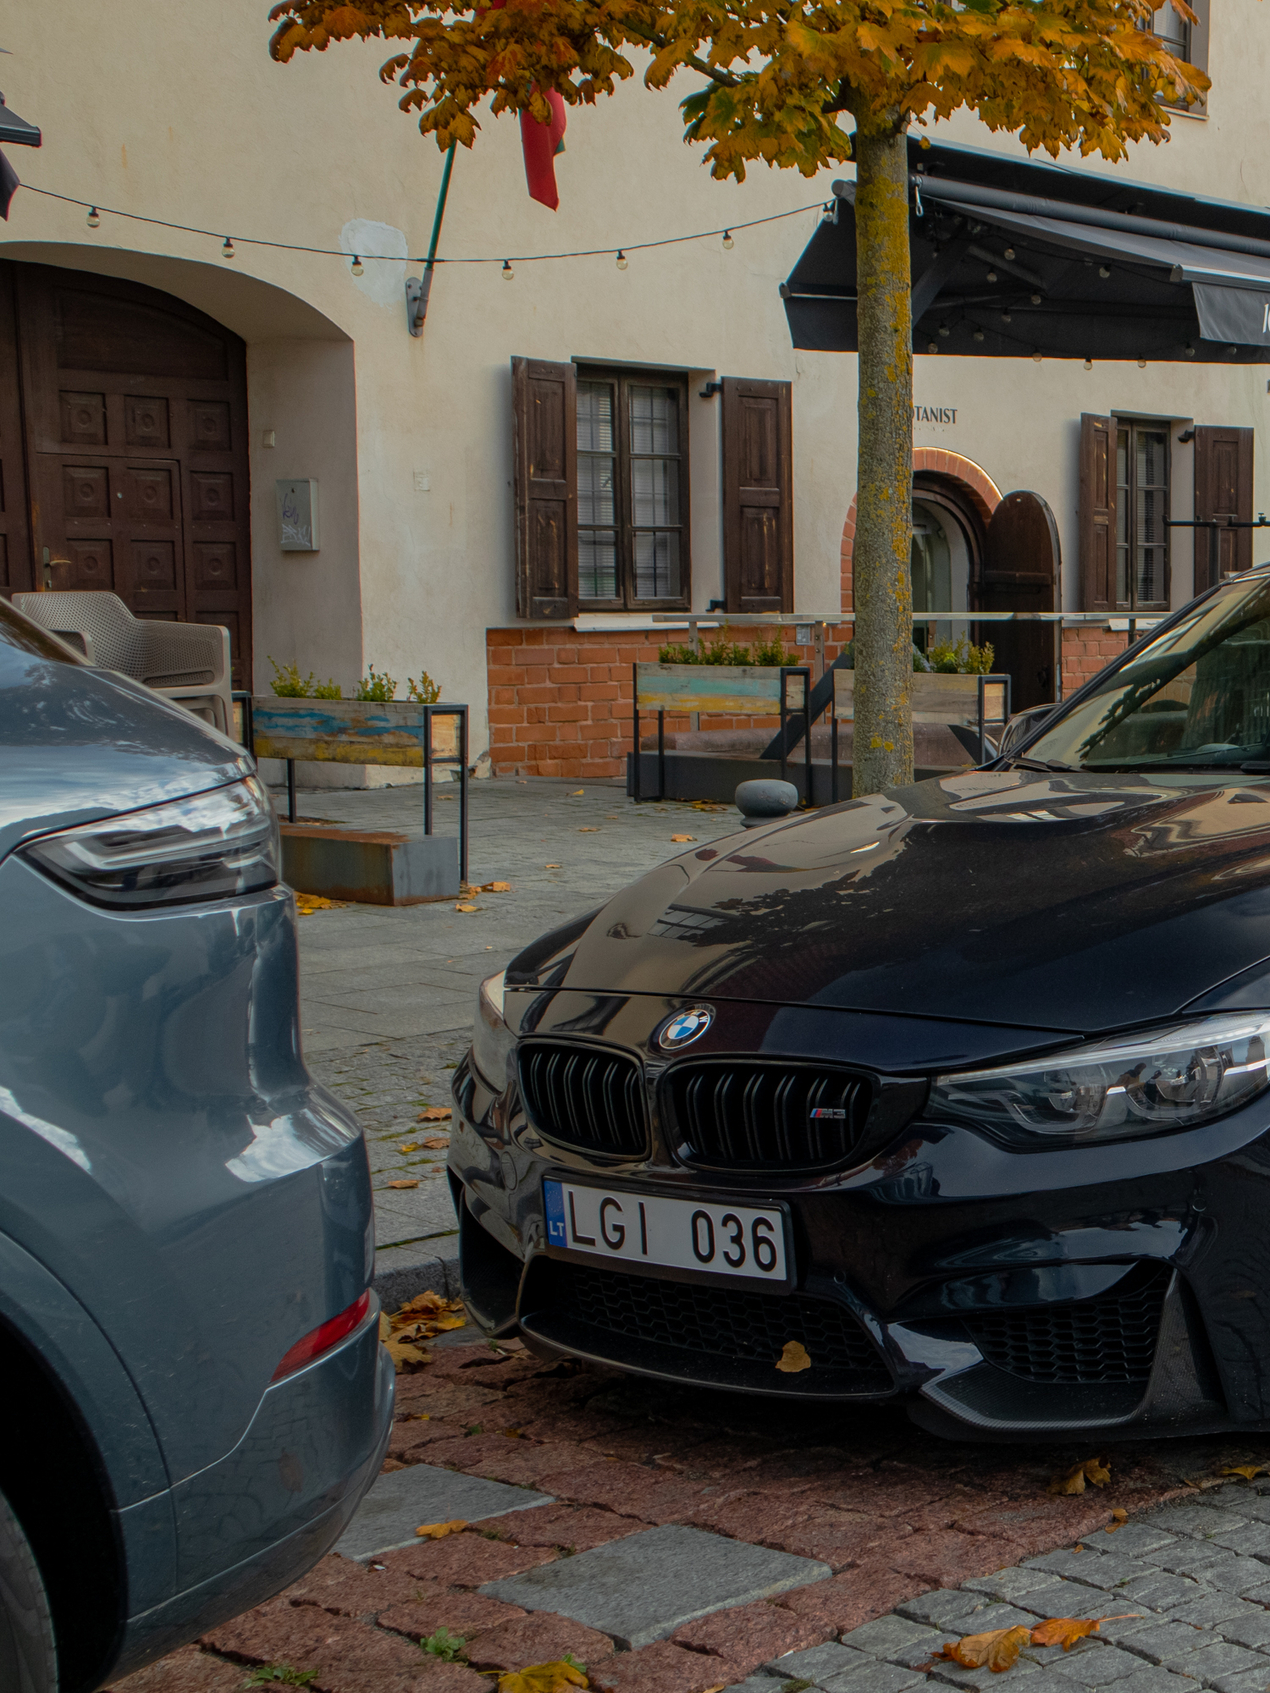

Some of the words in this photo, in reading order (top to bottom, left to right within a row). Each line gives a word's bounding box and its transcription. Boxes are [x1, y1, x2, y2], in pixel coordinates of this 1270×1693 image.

[912, 405, 958, 424] TANIST
[819, 1108, 846, 1119] M3
[549, 1219, 566, 1239] LT
[568, 1188, 649, 1256] LGI
[690, 1207, 778, 1273] 036
